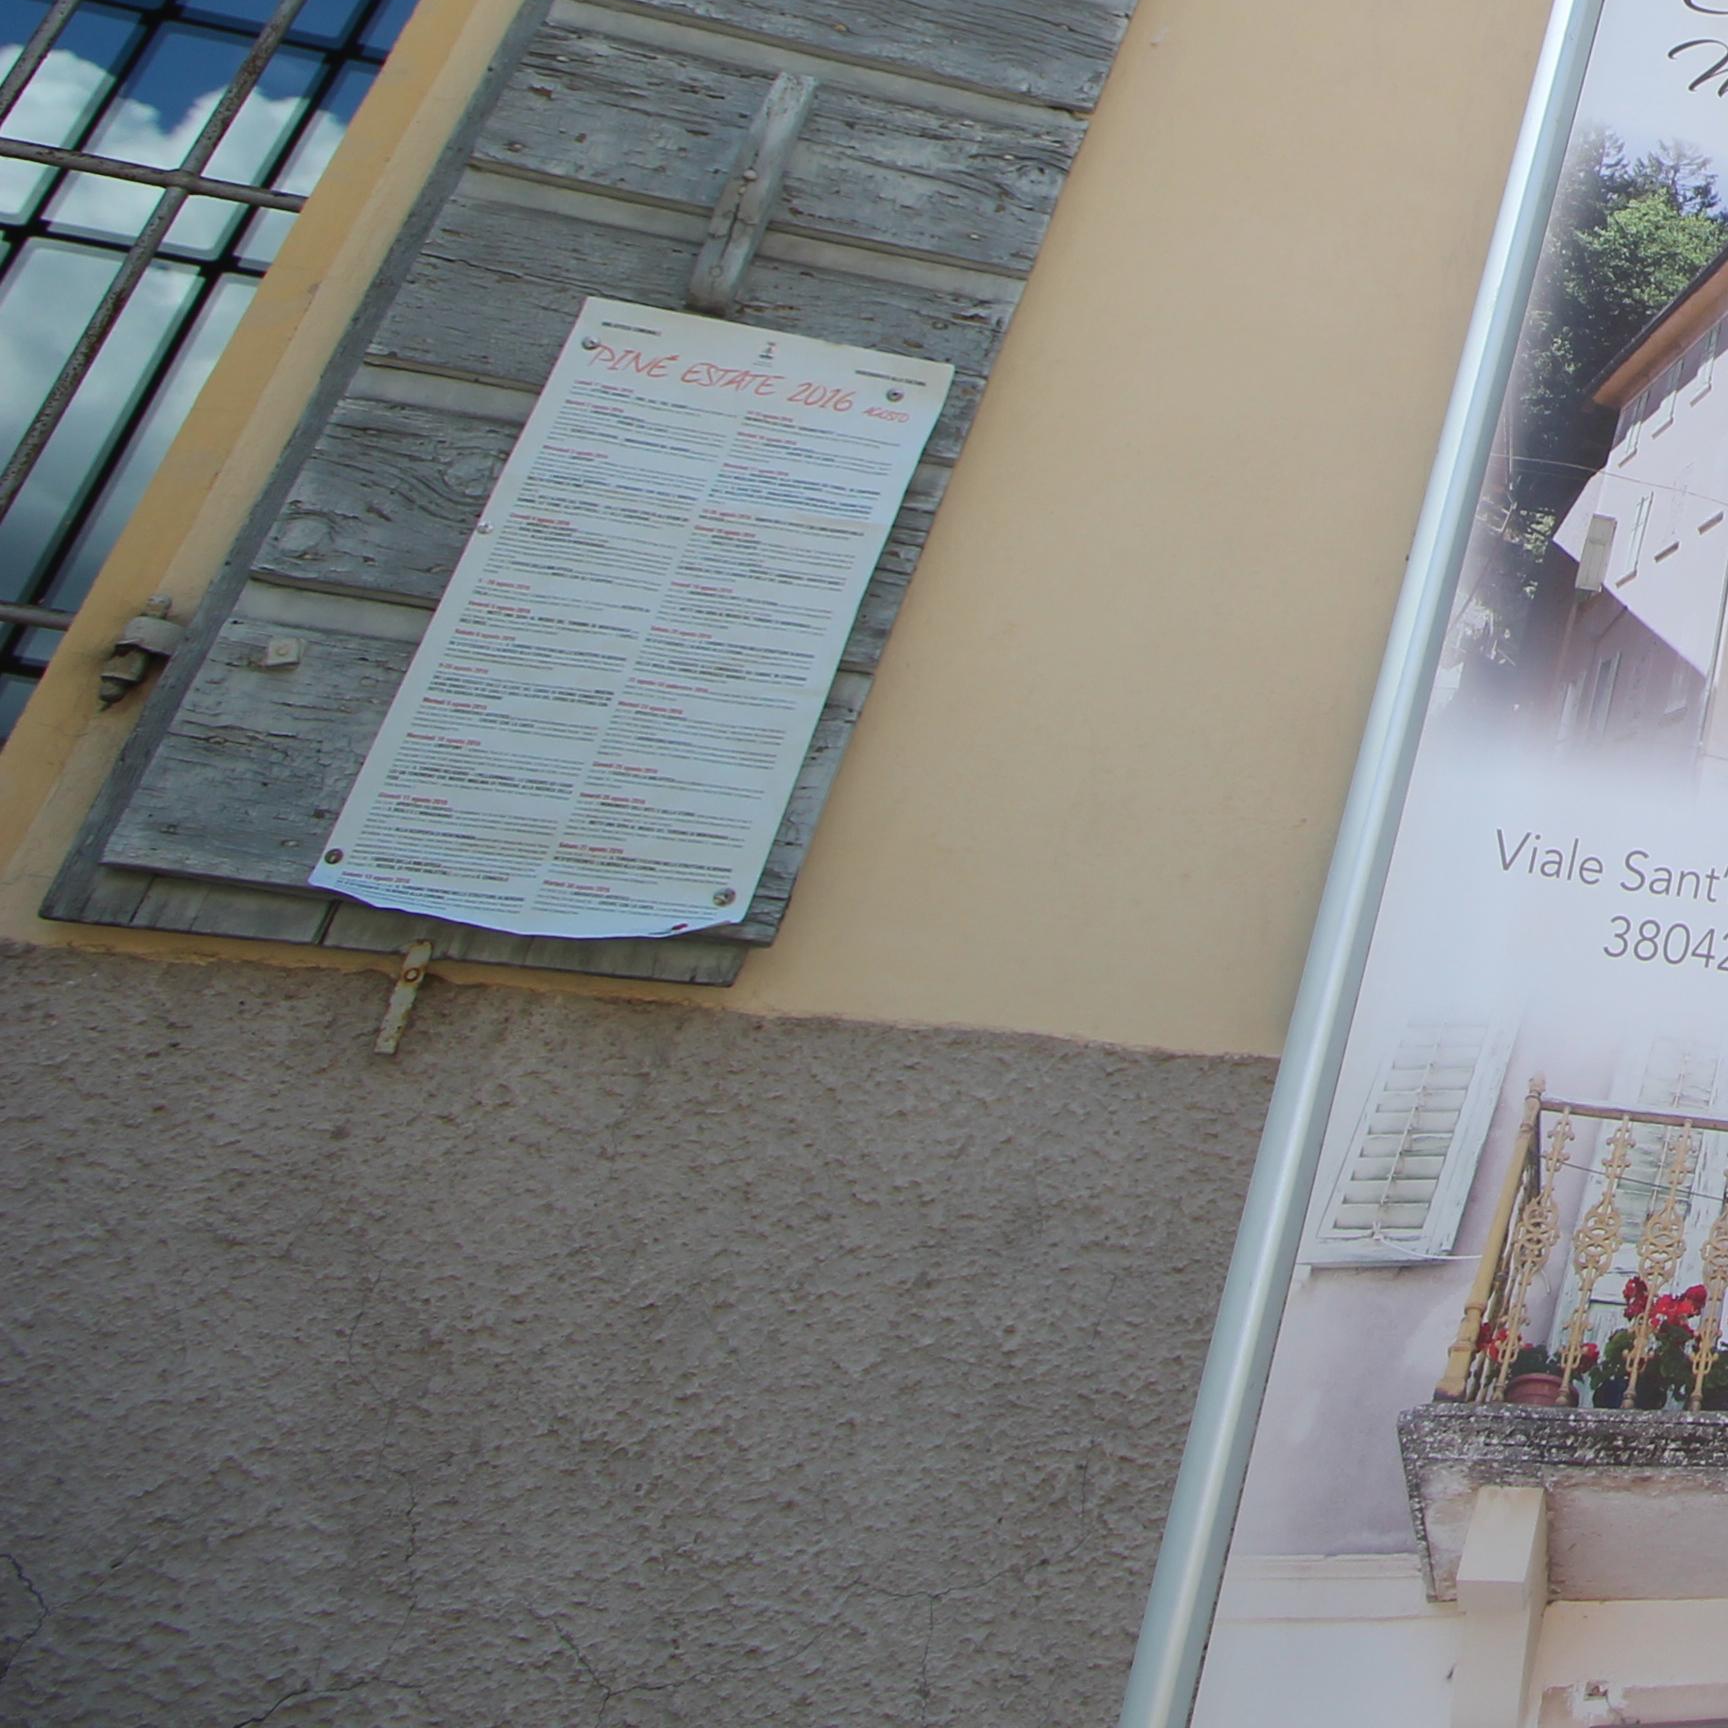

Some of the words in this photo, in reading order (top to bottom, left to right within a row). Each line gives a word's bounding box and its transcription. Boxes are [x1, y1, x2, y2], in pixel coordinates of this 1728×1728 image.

[592, 342, 682, 378] PINÉ
[682, 362, 785, 398] ESTATE
[787, 381, 857, 412] 2016
[1494, 829, 1605, 885] Viale
